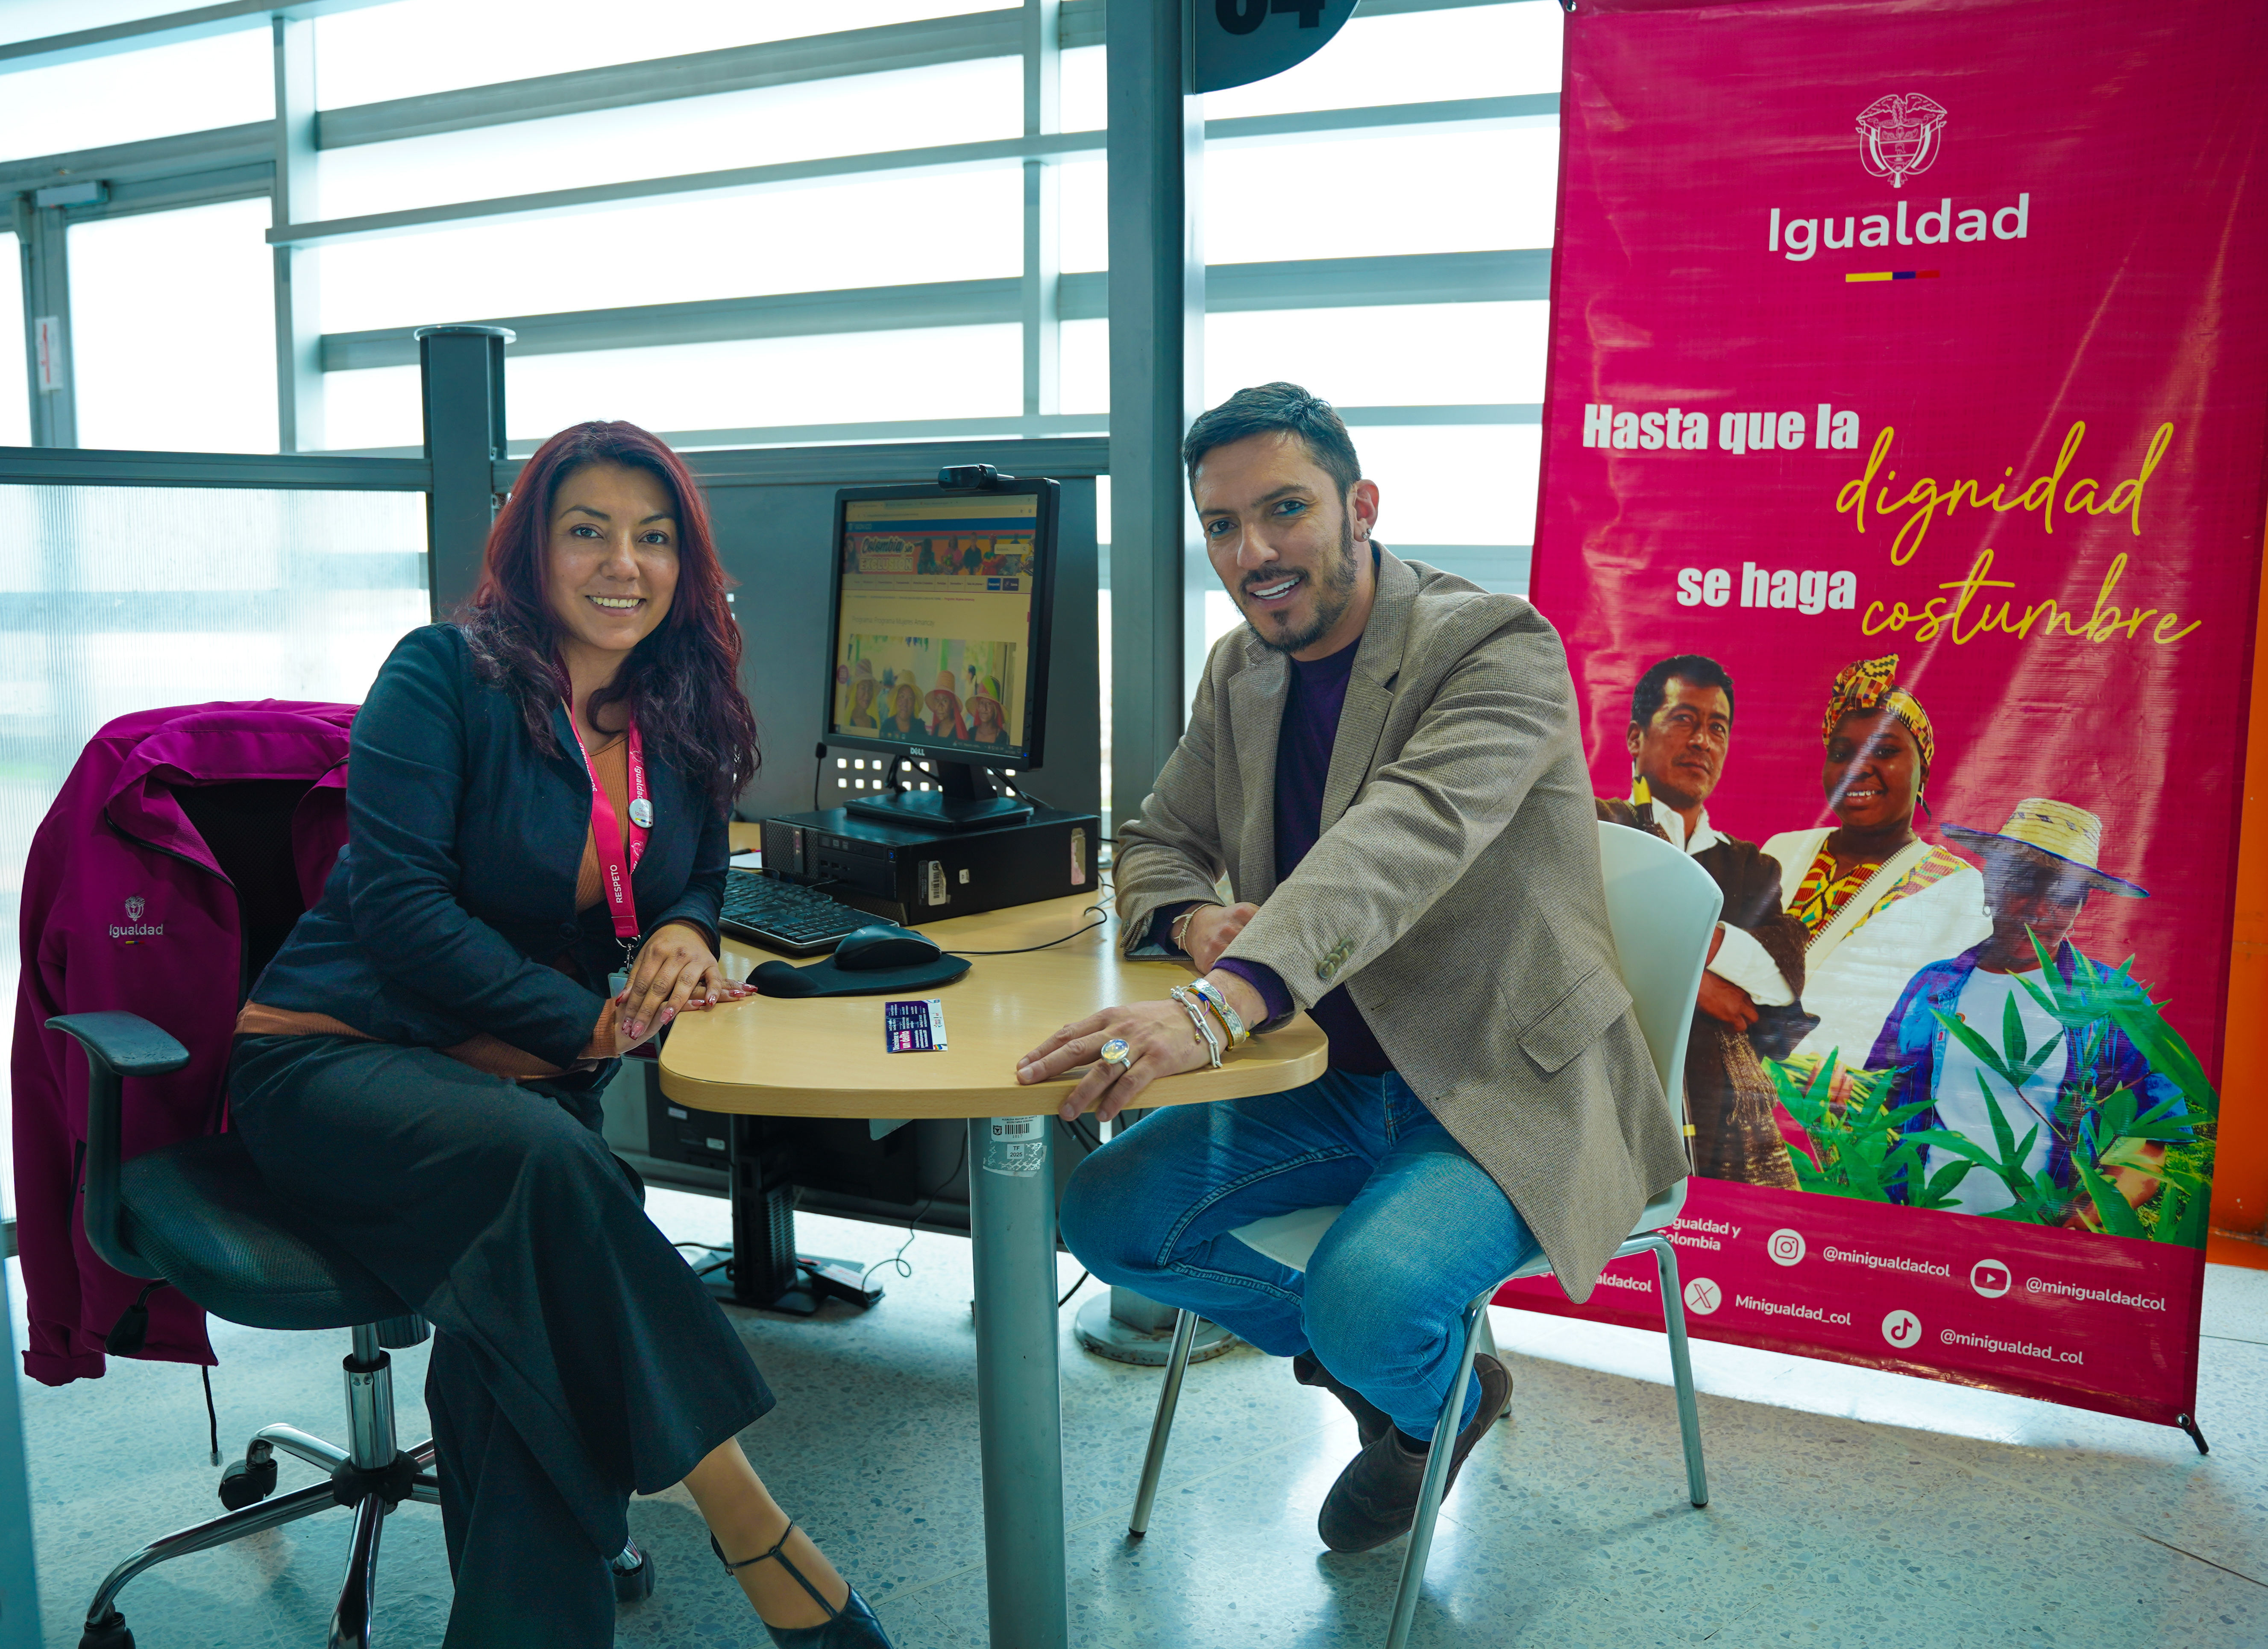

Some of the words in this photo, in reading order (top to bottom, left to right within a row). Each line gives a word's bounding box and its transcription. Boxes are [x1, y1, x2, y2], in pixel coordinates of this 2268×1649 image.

[1769, 193, 2029, 261] Igualdad
[1582, 404, 1709, 450] Hasta
[1719, 411, 1805, 455] que
[1815, 403, 1859, 450] la
[1836, 420, 2174, 566] dignidad
[862, 538, 905, 554] Colombia
[1676, 568, 1731, 607] se
[1740, 562, 1857, 615] haga
[1862, 548, 2202, 644] costumbre
[910, 747, 925, 756] DELL
[610, 864, 623, 903] RESPETO
[109, 923, 164, 938] Igualdad
[899, 1031, 910, 1042] delito
[1670, 1217, 1730, 1235] gualdad
[1731, 1226, 1742, 1239] y
[1823, 1246, 1951, 1277] @minigualdadcol
[1735, 1294, 1851, 1326] Minigualdad_col
[2026, 1277, 2166, 1311] @minigualdadcol
[1940, 1329, 2084, 1365] @minigualdad_col
